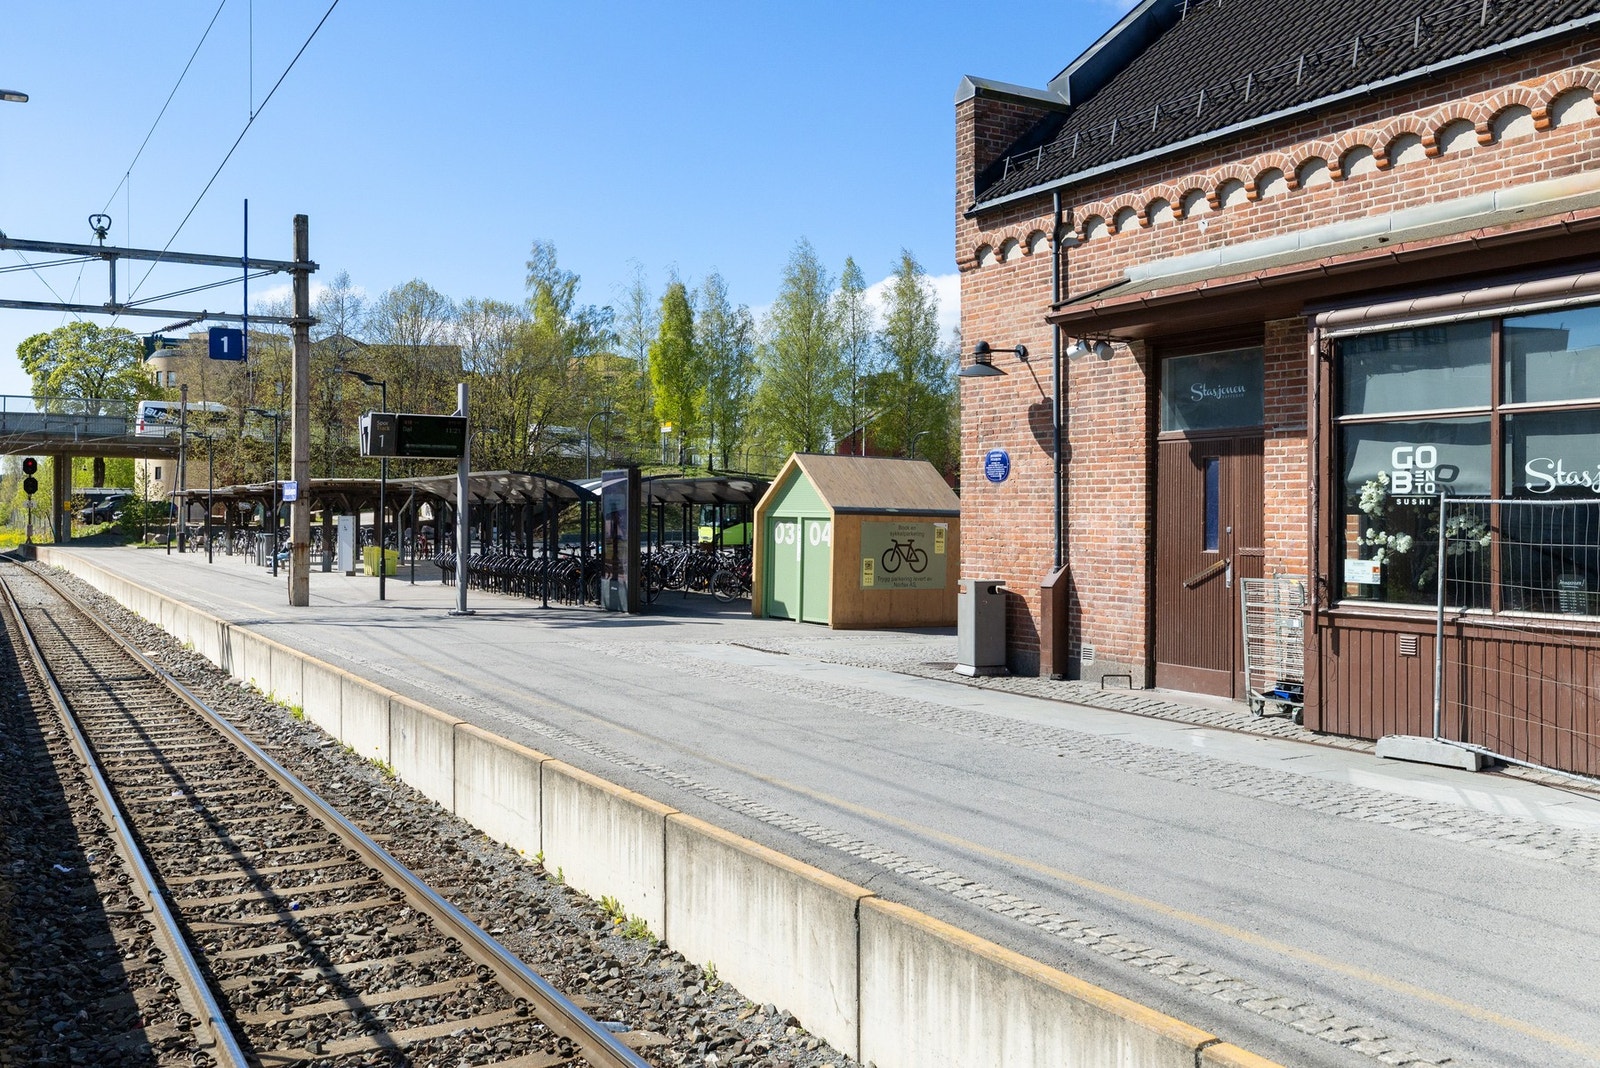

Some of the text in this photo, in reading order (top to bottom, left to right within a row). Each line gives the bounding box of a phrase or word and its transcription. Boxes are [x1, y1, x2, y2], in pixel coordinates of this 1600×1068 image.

[220, 336, 228, 353] 1
[1190, 382, 1245, 401] Stasjonen
[379, 434, 384, 448] 1
[1392, 445, 1437, 470] GO
[1396, 498, 1431, 506] SUSHI
[775, 521, 795, 545] 03
[809, 522, 831, 547] 04
